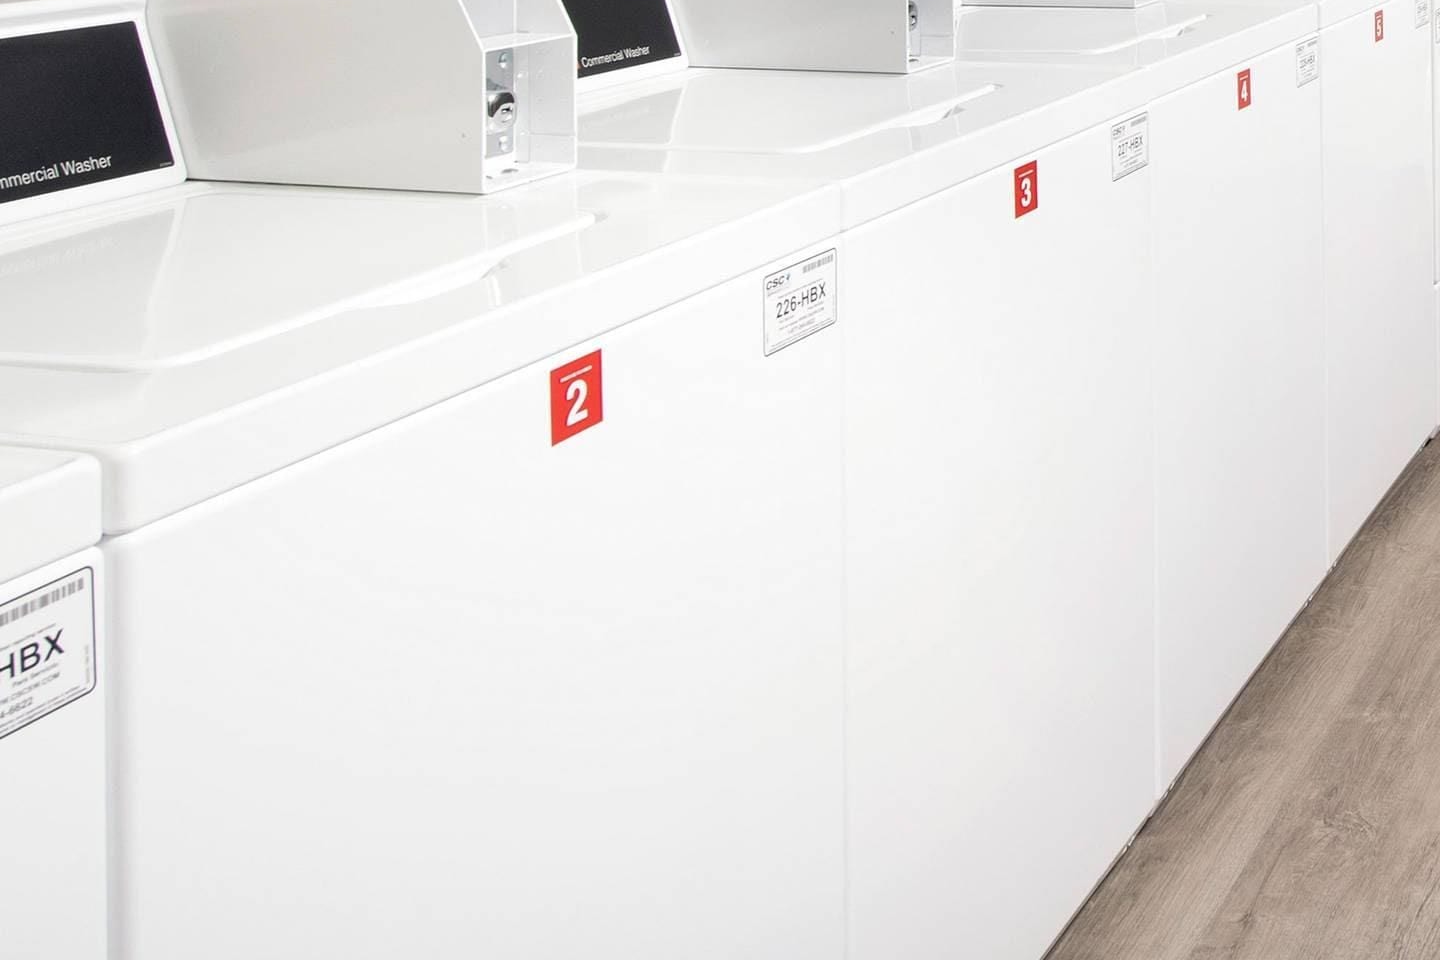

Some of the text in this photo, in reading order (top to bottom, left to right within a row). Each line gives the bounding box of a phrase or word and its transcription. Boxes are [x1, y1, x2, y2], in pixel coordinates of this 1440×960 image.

[581, 44, 650, 68] Commercial Washer
[1241, 80, 1248, 102] 4
[60, 154, 112, 176] Washer
[1021, 178, 1031, 207] 3
[766, 275, 785, 291] CSC
[776, 282, 826, 318] 226-HBX
[566, 378, 588, 427] 2
